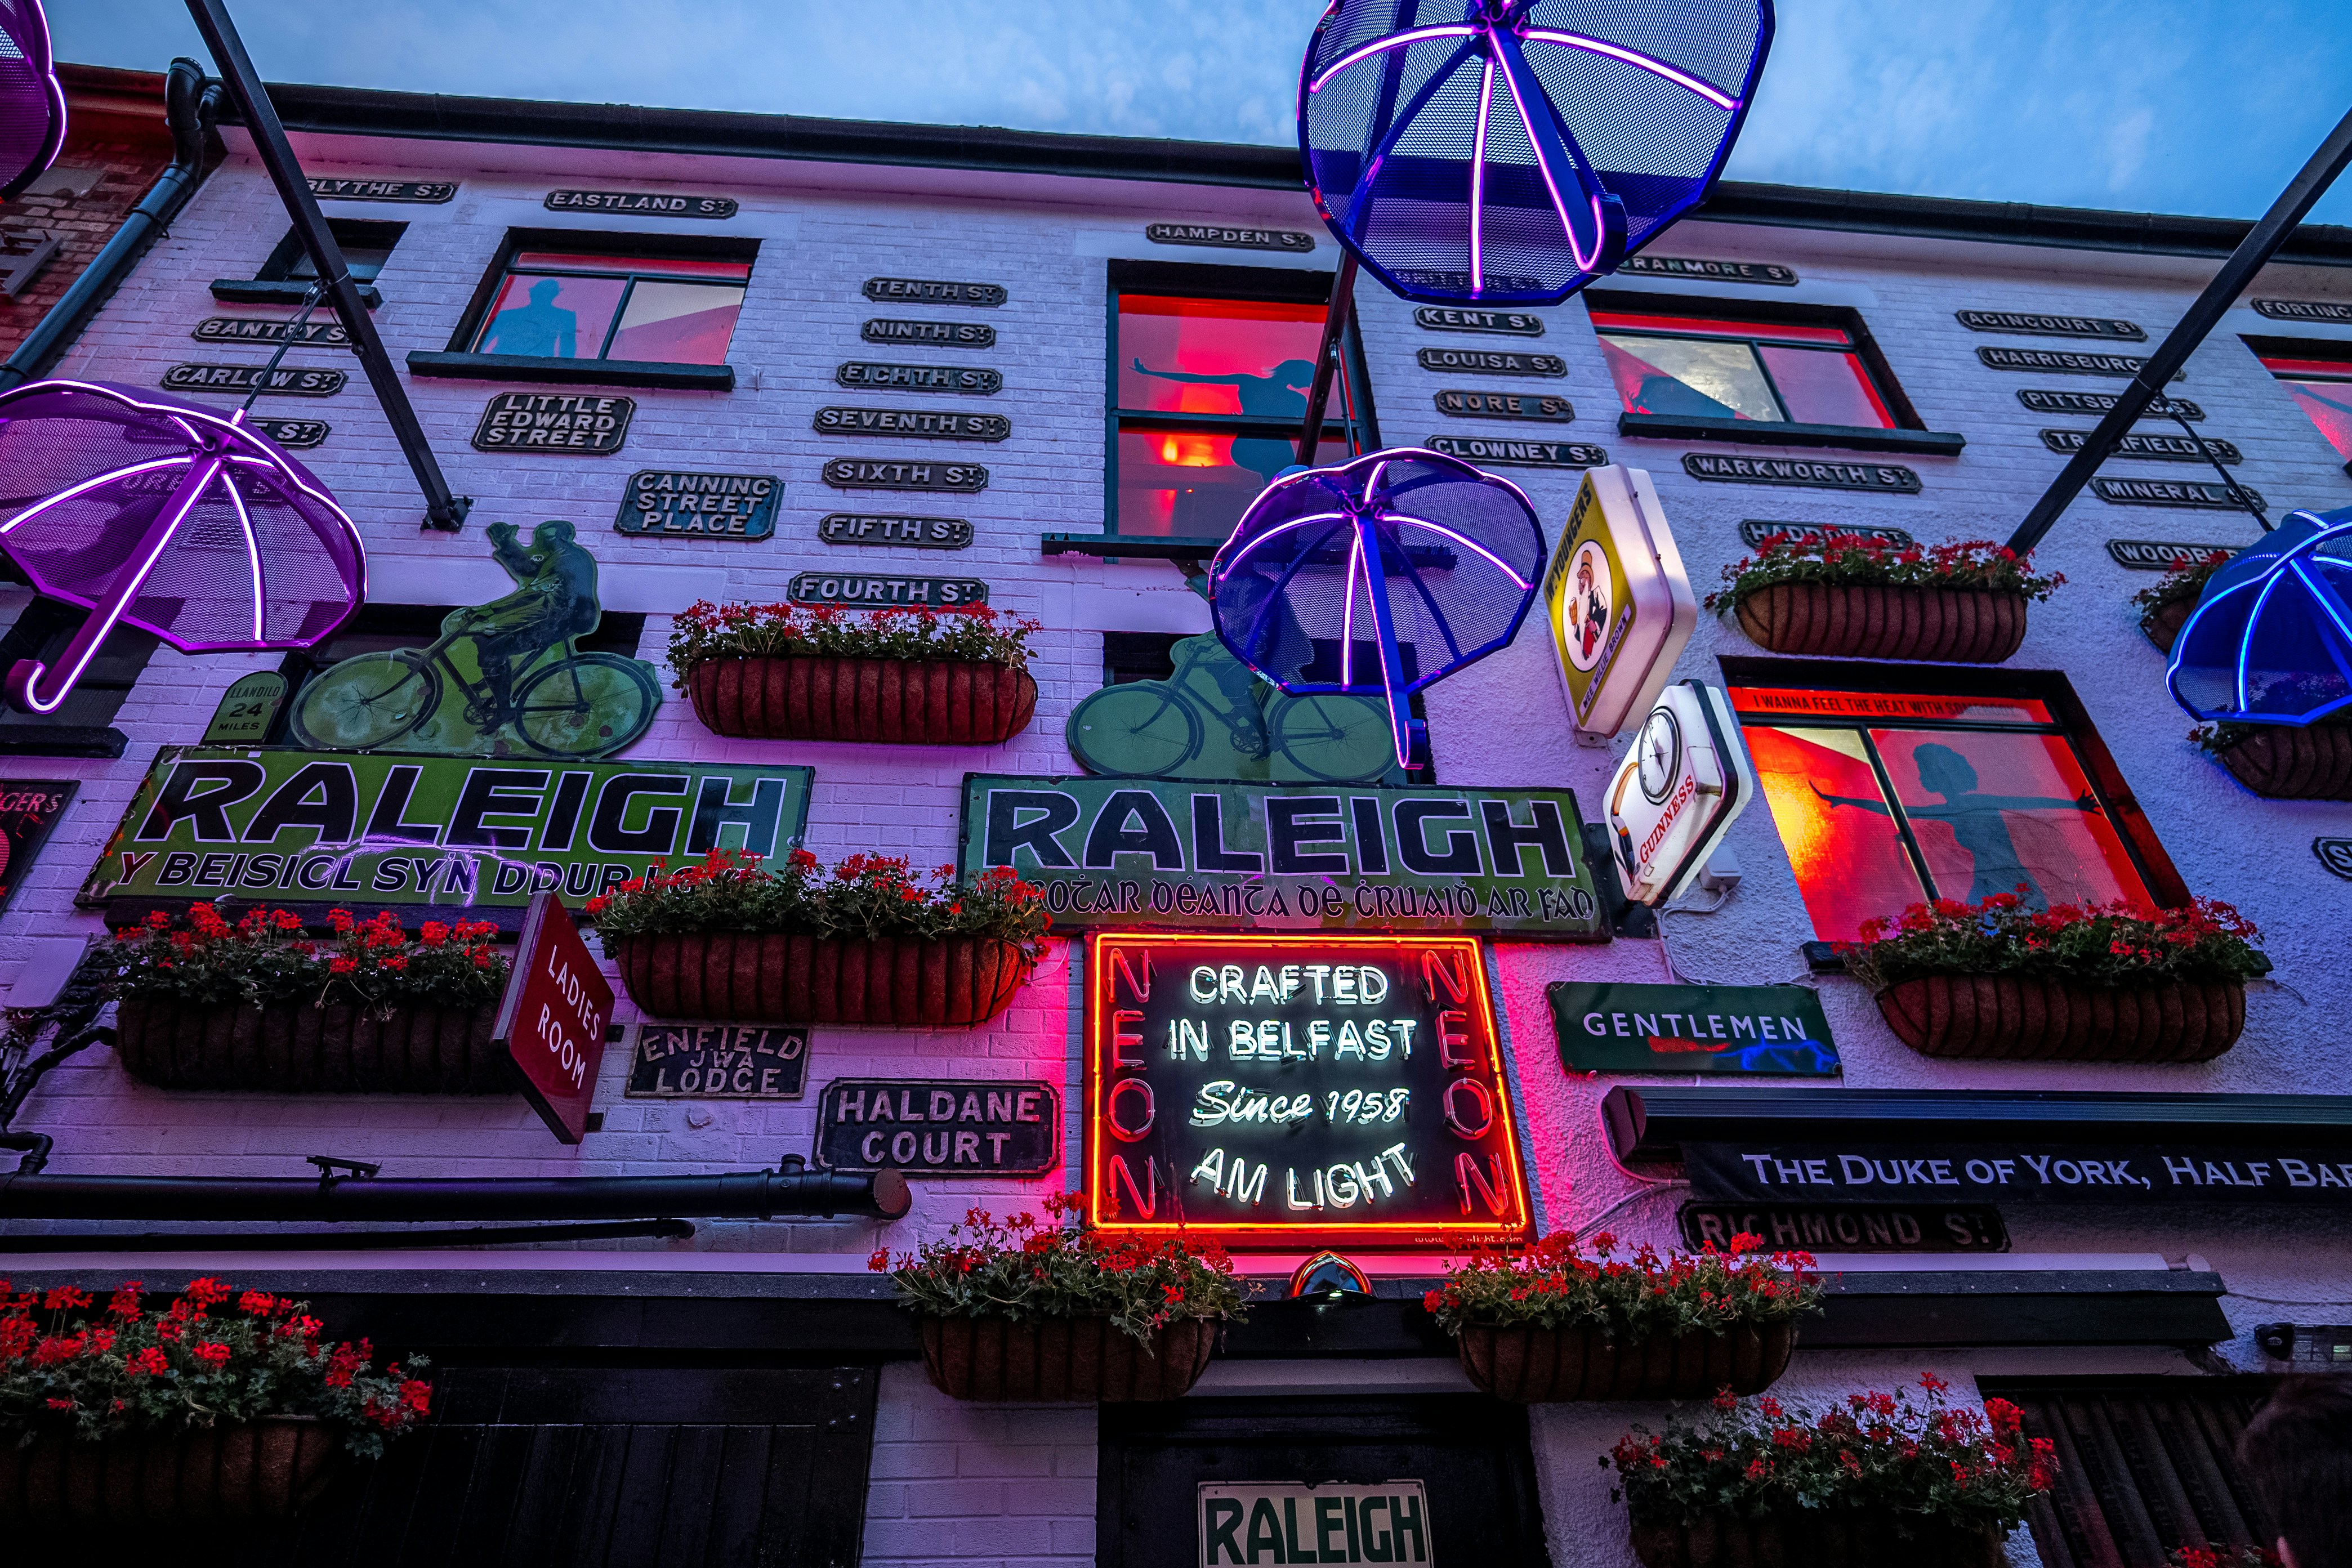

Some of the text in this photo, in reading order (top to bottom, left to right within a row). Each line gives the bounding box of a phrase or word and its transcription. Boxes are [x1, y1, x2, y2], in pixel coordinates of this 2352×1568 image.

[552, 193, 686, 211] EASTLAND
[1156, 226, 1269, 243] HAMPDEN
[873, 282, 958, 297] TENTH
[1424, 310, 1495, 326] KENT
[869, 322, 950, 338] NINTH
[1426, 351, 1521, 369] LOUISA
[170, 366, 296, 387] CARLOW
[505, 395, 616, 413] LITTLE
[1445, 394, 1522, 412] NORE
[490, 411, 615, 431] EDWARD
[822, 410, 957, 431] SEVENTH
[487, 428, 611, 446] STREET
[1435, 439, 1557, 461] CLOWNEY
[836, 463, 931, 483] SIXTH
[1695, 457, 1867, 483] WARKWORTH
[637, 493, 762, 513] STREET
[2103, 482, 2223, 502] MINERAL
[642, 511, 748, 532] PLACE
[828, 518, 922, 539] FIFTH
[798, 578, 929, 602] FOURTH
[1583, 614, 1627, 709] WEE WILLIE BROWN
[230, 686, 280, 698] LLANDILO
[229, 703, 263, 717] 24
[1753, 695, 1759, 708] I
[1761, 695, 1811, 709] WANNA
[1811, 697, 1845, 711] FEEL
[1845, 698, 1873, 712] THE
[1872, 699, 1907, 713] HEAT
[1908, 700, 1943, 715] WITH
[133, 759, 787, 859] RALEIGH
[1640, 775, 1695, 863] GUINNESS
[983, 789, 1576, 878] RALEIGH
[118, 851, 158, 885] Y
[156, 852, 362, 891] BEISICL
[1487, 886, 1533, 917] AR
[548, 945, 600, 1040] LADIES
[1191, 965, 1389, 1004] CRAFTED
[1583, 1013, 1807, 1040] GENTLEMEN
[538, 1002, 585, 1089] ROOM
[642, 1027, 802, 1062] ENFIELD
[1170, 1018, 1416, 1060] IN BELFAST
[657, 1068, 781, 1093] LODGE
[837, 1089, 1041, 1123] HALDANE
[1191, 1080, 1409, 1124] Since 1958
[861, 1131, 1011, 1165] COURT
[1191, 1142, 1416, 1210] AM LIGHT
[1697, 1213, 1920, 1245] RICHMOND
[1204, 1495, 1426, 1565] RALEIGH
